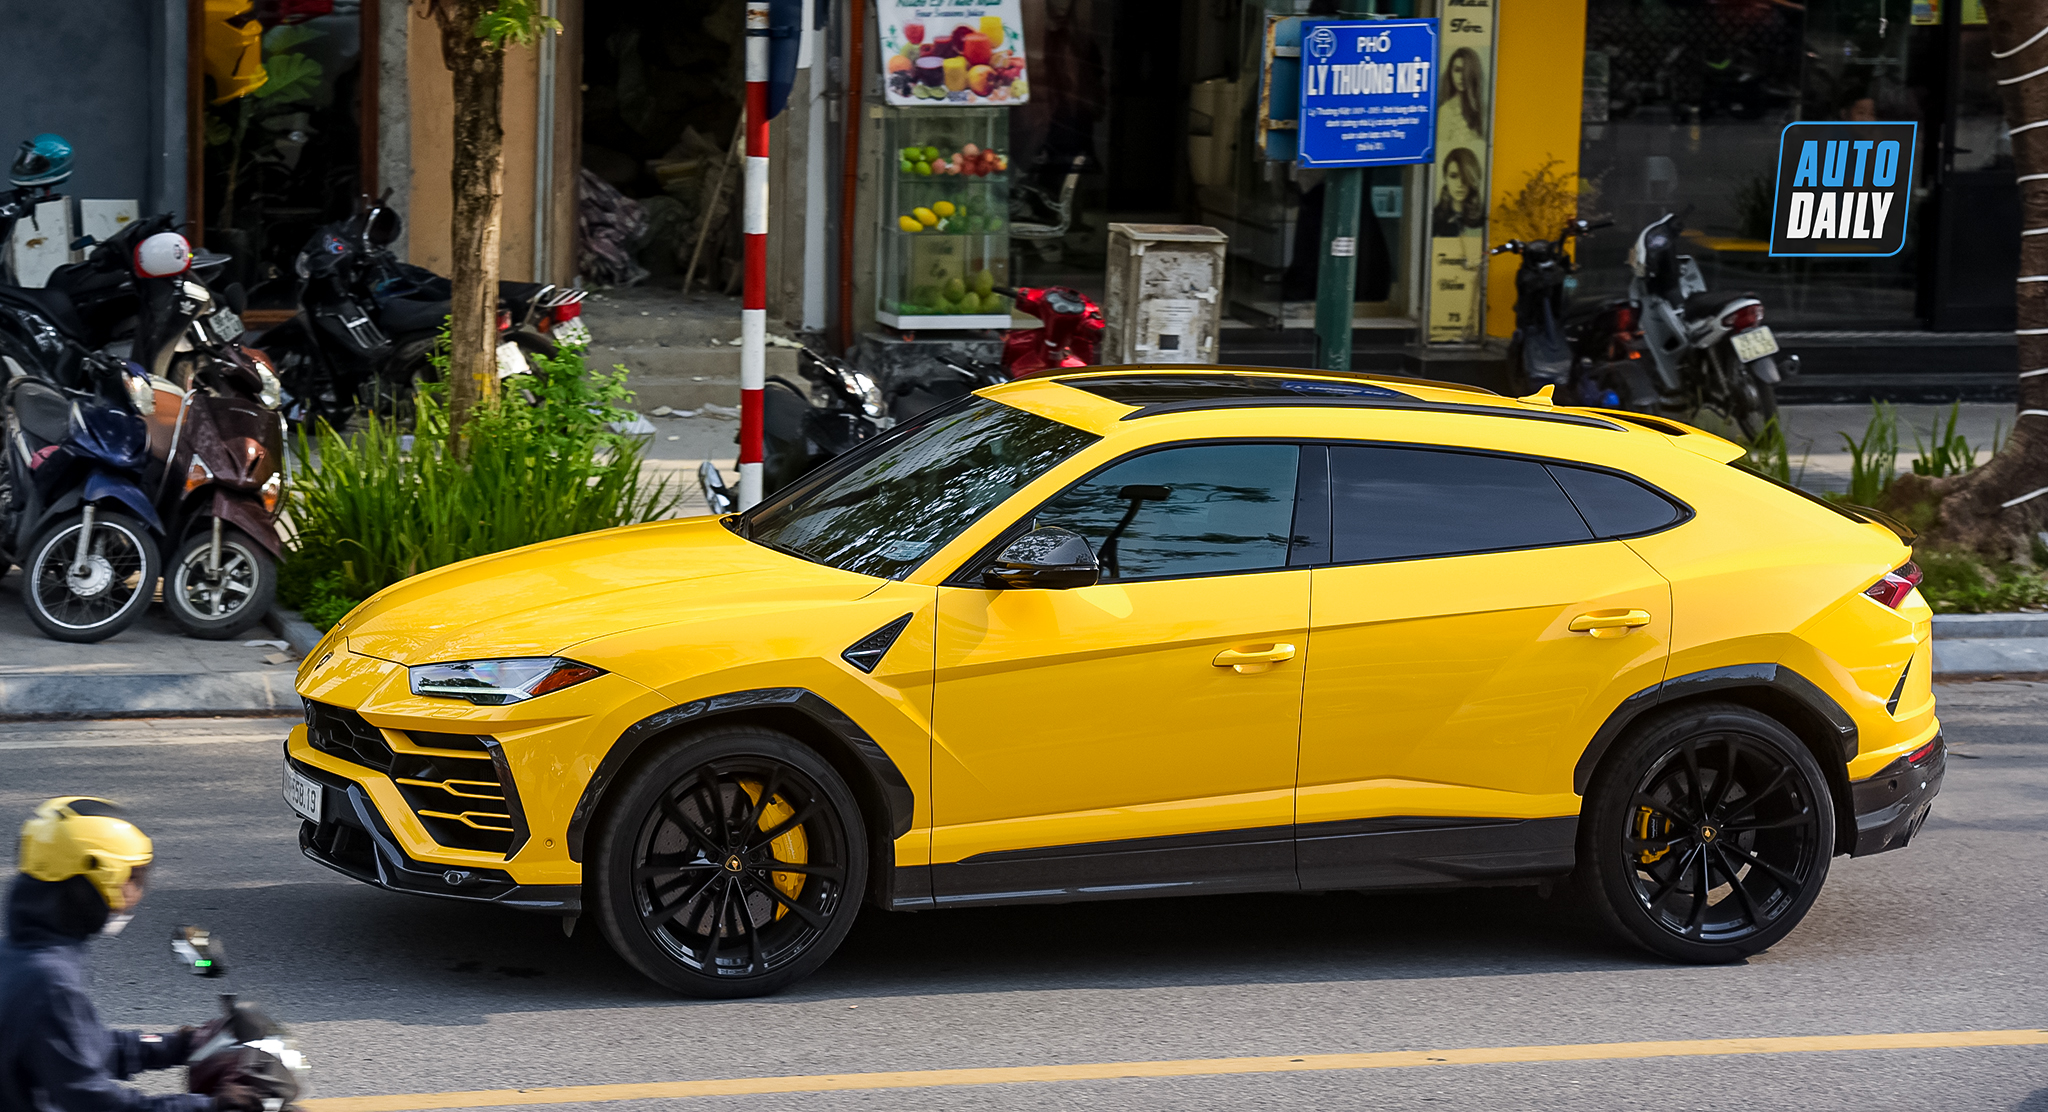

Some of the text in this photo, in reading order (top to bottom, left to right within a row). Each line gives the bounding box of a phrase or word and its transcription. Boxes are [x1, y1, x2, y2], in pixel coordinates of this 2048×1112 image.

[1356, 30, 1391, 53] PHỐ
[1307, 56, 1430, 98] LÝ THƯỜNG KIỆT
